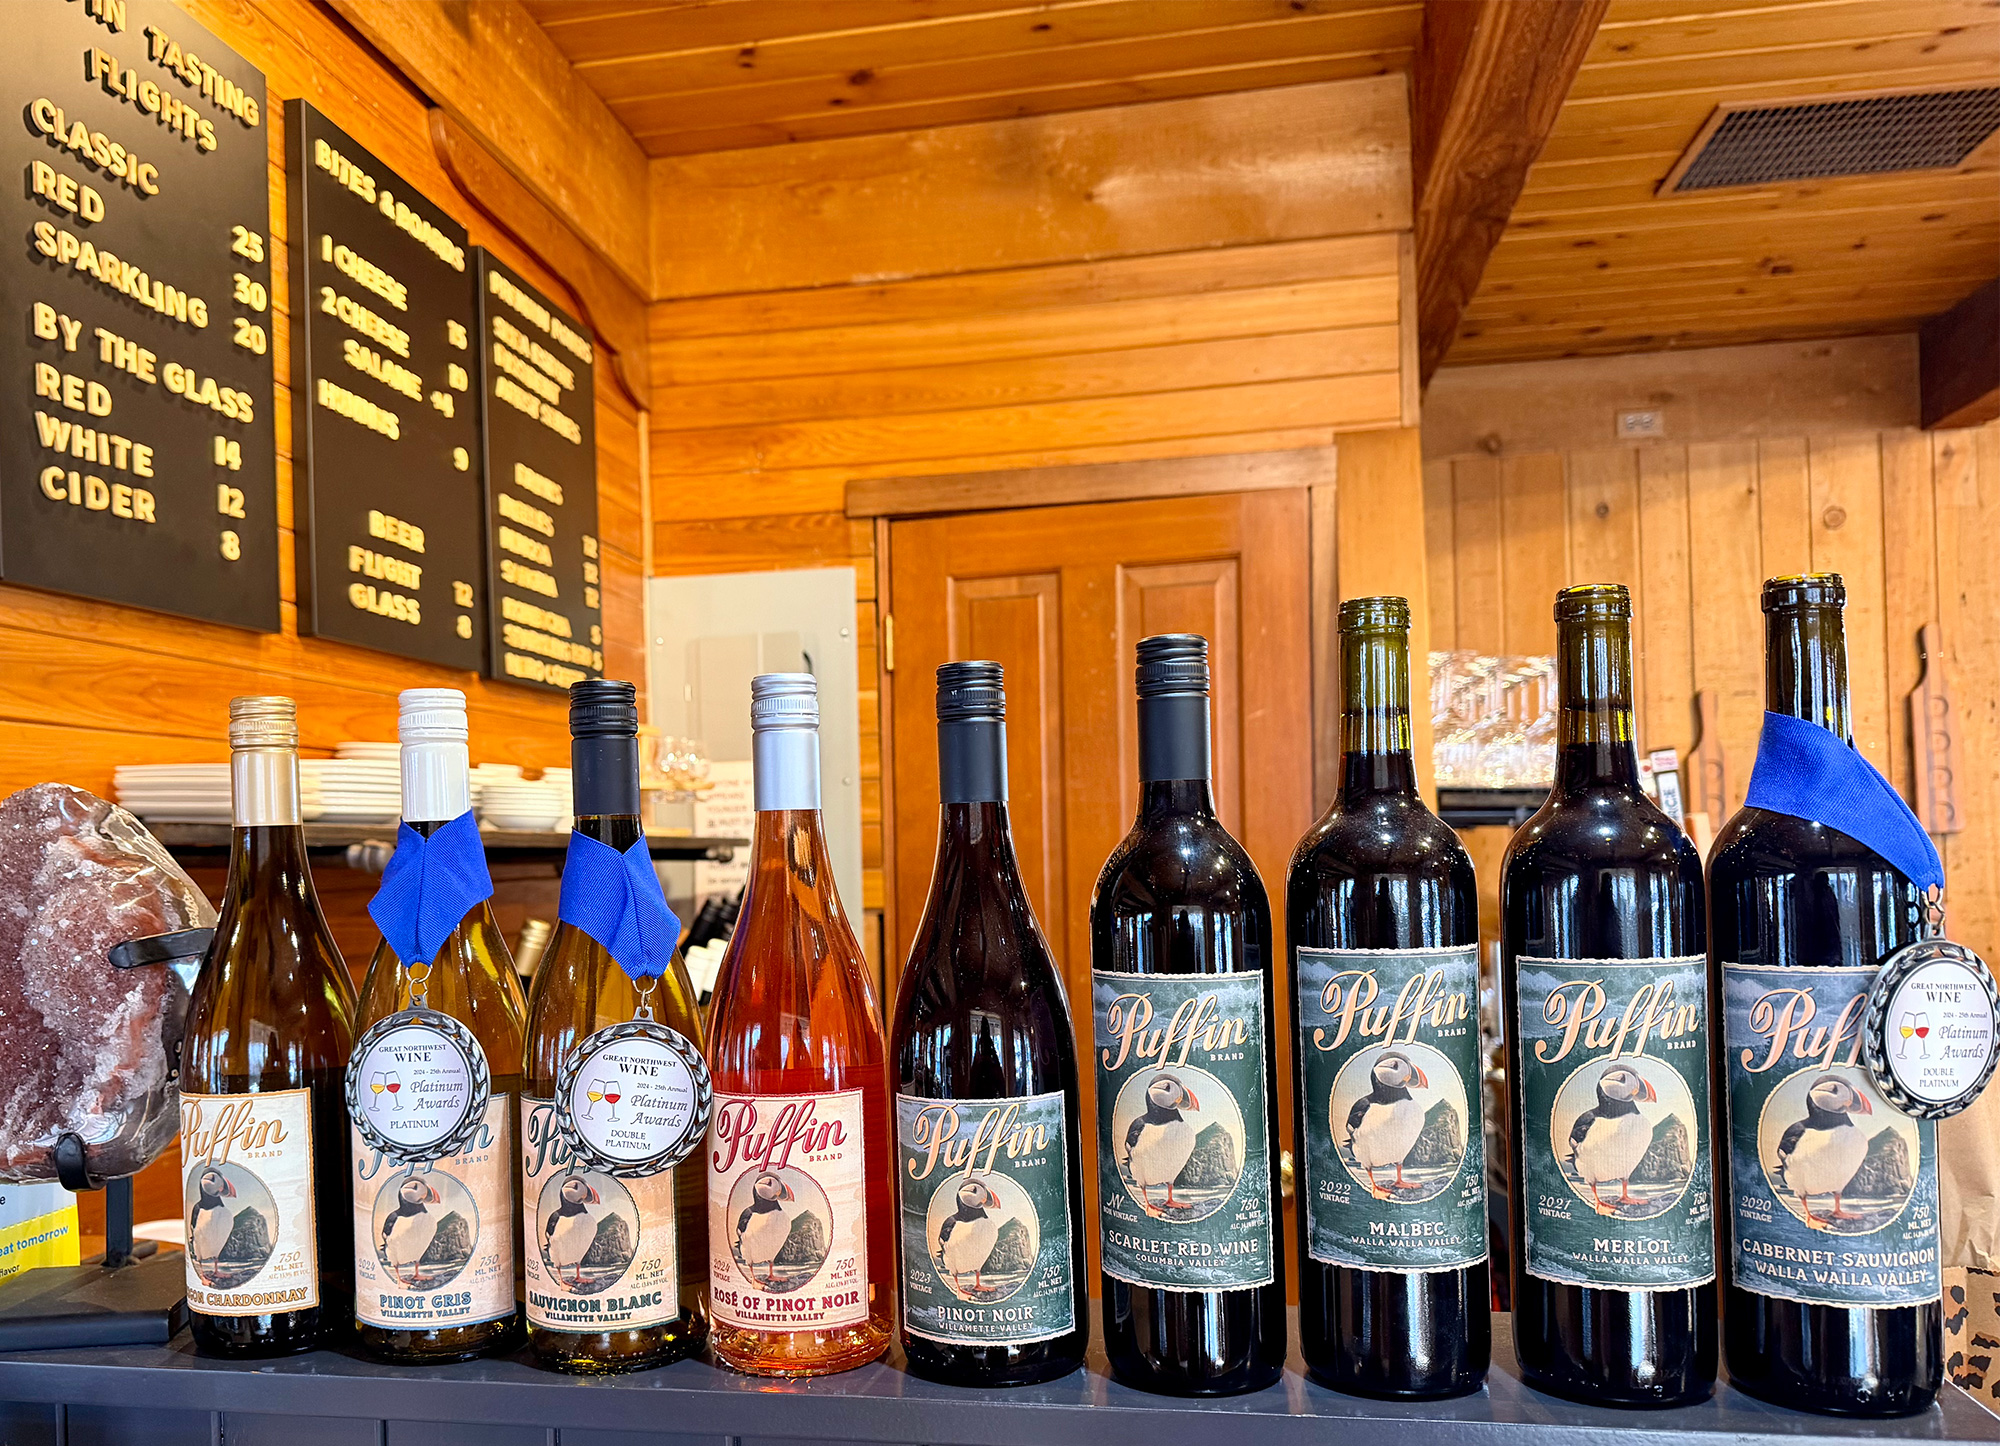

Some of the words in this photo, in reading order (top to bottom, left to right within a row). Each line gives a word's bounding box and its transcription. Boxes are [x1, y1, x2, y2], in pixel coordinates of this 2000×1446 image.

[149, 25, 259, 126] TASTING
[91, 47, 218, 151] FLIGHTS
[315, 138, 376, 204] BITES
[31, 98, 159, 195] CLASSIC
[231, 225, 264, 263] 25
[32, 160, 105, 222] RED
[233, 273, 267, 312] 30
[34, 221, 208, 328] SPARKLING
[233, 318, 267, 355] 20
[320, 286, 337, 316] 2
[34, 302, 82, 351] BY
[94, 327, 157, 384] THE
[163, 362, 254, 423] GLASS
[35, 361, 112, 416] RED
[214, 435, 242, 471] 14
[34, 411, 154, 478] WHITE
[217, 483, 246, 519] 12
[40, 466, 156, 523] CIDER
[220, 530, 241, 561] 8
[369, 509, 425, 553] BEER
[348, 545, 422, 590] FLIGHT
[348, 583, 421, 625] GLASS
[1911, 982, 1934, 990] GREAT
[1935, 983, 1977, 991] NORTHWEST
[1926, 991, 1962, 1003] WINE
[1313, 968, 1469, 1051] Puffin
[1969, 1011, 1988, 1019] Annual
[1535, 979, 1699, 1064] Puffin
[1102, 992, 1249, 1071] Puffin
[1437, 1027, 1467, 1037] BRAND
[1938, 1024, 1989, 1040] Platinum
[378, 1045, 402, 1053] GREAT
[403, 1044, 447, 1052] NORTHWEST
[1667, 1040, 1697, 1050] BRAND
[1939, 1043, 1985, 1060] Awards
[395, 1052, 432, 1062] WINE
[602, 1053, 628, 1063] GREAT
[629, 1057, 678, 1068] NORTHWEST
[1210, 1052, 1244, 1061] BRAND
[619, 1063, 659, 1077] WINE
[1923, 1068, 1954, 1077] DOUBLE
[410, 1080, 463, 1093] Platinum
[667, 1086, 688, 1094] Annual
[1919, 1079, 1959, 1088] PLATINUM
[413, 1095, 460, 1111] Awards
[630, 1094, 688, 1111] Platinum
[390, 1119, 439, 1129] PLATINUM
[630, 1112, 682, 1127] Awards
[181, 1099, 288, 1167] Puffin
[610, 1129, 646, 1140] DOUBLE
[713, 1098, 847, 1173] Puffin
[605, 1139, 651, 1150] PLATINUM
[907, 1103, 1050, 1180] Puffin
[247, 1150, 283, 1159] BRAND
[455, 1154, 489, 1166] BRAND
[809, 1153, 843, 1163] BRAND
[1014, 1157, 1047, 1168] BRAND
[1319, 1179, 1351, 1195] 2022
[1465, 1173, 1478, 1188] 750
[1240, 1197, 1258, 1211] 750
[1319, 1192, 1350, 1205] VINTAGE
[1538, 1195, 1572, 1211] 2021
[1693, 1191, 1707, 1205] 750
[1741, 1196, 1772, 1213] 2020
[1112, 1210, 1138, 1222] VINTAGE
[1249, 1210, 1261, 1219] NET
[1538, 1206, 1571, 1220] VINTAGE
[1739, 1208, 1772, 1223] VINTAGE
[1912, 1205, 1930, 1220] 750
[1368, 1221, 1445, 1237] MALBEC
[1920, 1218, 1932, 1228] NET
[16, 1226, 69, 1250] tomorrow
[1108, 1229, 1171, 1256] SCARLET
[1177, 1242, 1212, 1256] RED
[1219, 1238, 1259, 1256] WINE
[1350, 1235, 1385, 1247] WALLA
[1389, 1238, 1424, 1247] WALLA
[1427, 1236, 1461, 1247] VALLEY
[1592, 1238, 1671, 1254] MERLOT
[1742, 1238, 1835, 1266] CABERNET
[1842, 1246, 1935, 1268] SAUVIGNON
[279, 1250, 301, 1264] 750
[479, 1253, 499, 1267] 750
[835, 1257, 855, 1271] 750
[1135, 1253, 1185, 1267] COLUMBIA
[1189, 1258, 1225, 1267] VALLEY
[1572, 1252, 1608, 1264] WALLA
[1613, 1256, 1650, 1265] WALLA
[1654, 1254, 1689, 1265] VALLEY
[289, 1261, 304, 1270] NET
[358, 1258, 376, 1271] 2024
[488, 1264, 502, 1273] NET
[641, 1258, 661, 1272] 750
[713, 1258, 731, 1272] 2024
[650, 1269, 664, 1279] NET
[844, 1268, 858, 1278] NET
[910, 1269, 932, 1284] 2023
[1042, 1264, 1060, 1281] 750
[1754, 1260, 1808, 1282] WALLA
[1813, 1270, 1872, 1286] WALLA
[1877, 1270, 1928, 1286] VALLEY
[1050, 1276, 1063, 1285] NET
[909, 1281, 933, 1295] VINTAGE
[207, 1286, 308, 1307] CHARDONNAY
[379, 1294, 425, 1309] PINOT
[431, 1291, 472, 1308] GRIS
[529, 1290, 600, 1312] SAUVIGNON
[607, 1291, 663, 1312] BLANC
[714, 1286, 738, 1307] ROSÉ
[742, 1296, 760, 1310] OF
[766, 1297, 816, 1312] PINOT
[822, 1291, 860, 1309] NOIR
[380, 1309, 433, 1319] WILLAMETTE
[436, 1307, 471, 1317] VALLEY
[545, 1311, 594, 1322] WILLAMETTE
[596, 1312, 632, 1322] VALLEY
[735, 1309, 787, 1321] WILLAMETTE
[790, 1312, 825, 1321] VALLEY
[938, 1306, 986, 1322] PINOT
[992, 1306, 1034, 1322] NOIR
[938, 1322, 996, 1332] WILLAMETTE
[999, 1322, 1034, 1332] VALLEY
